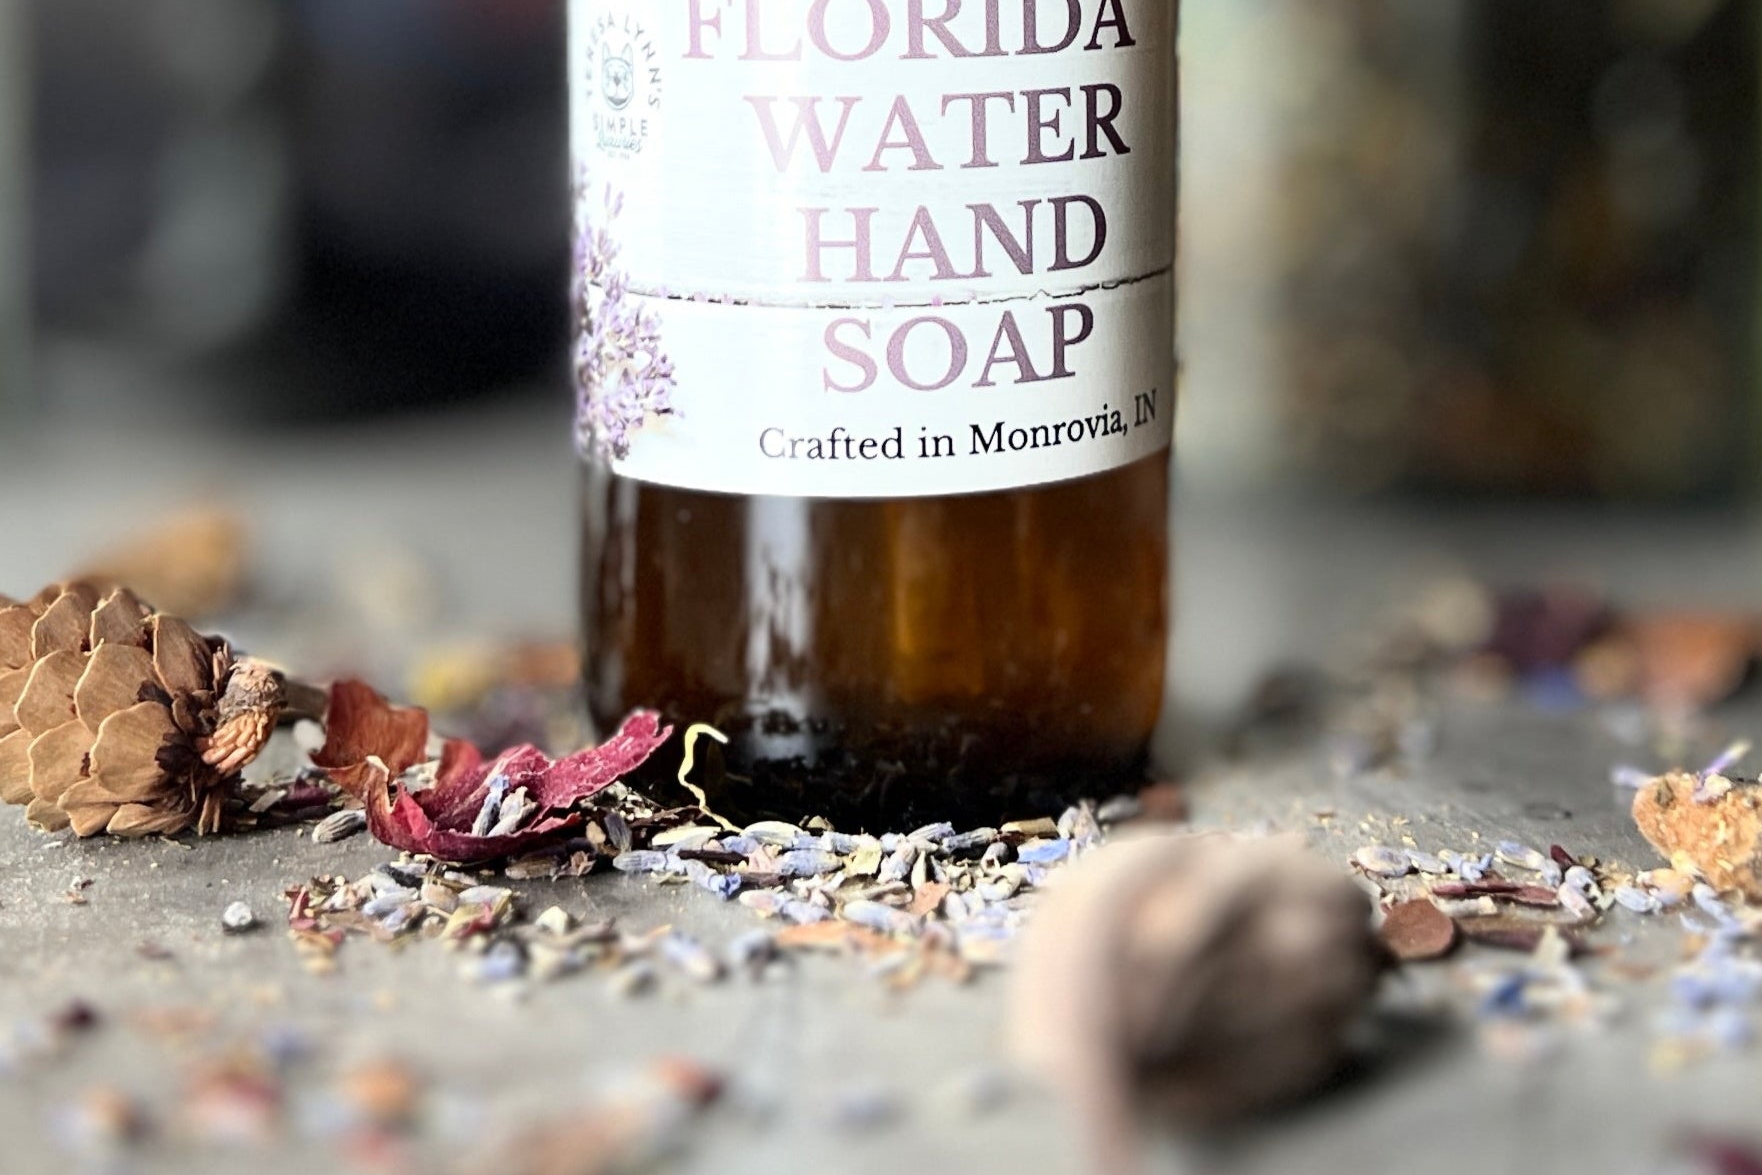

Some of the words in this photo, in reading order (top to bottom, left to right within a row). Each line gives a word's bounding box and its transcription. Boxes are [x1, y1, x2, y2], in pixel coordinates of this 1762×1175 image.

[593, 113, 648, 137] SIMPLE
[743, 83, 1130, 173] WATER
[796, 195, 1107, 283] HAND
[823, 303, 1094, 394] SOAP
[759, 426, 904, 461] Crafted
[918, 425, 955, 458] in
[969, 405, 1128, 456] Monrovia,
[1134, 389, 1157, 428] IN
